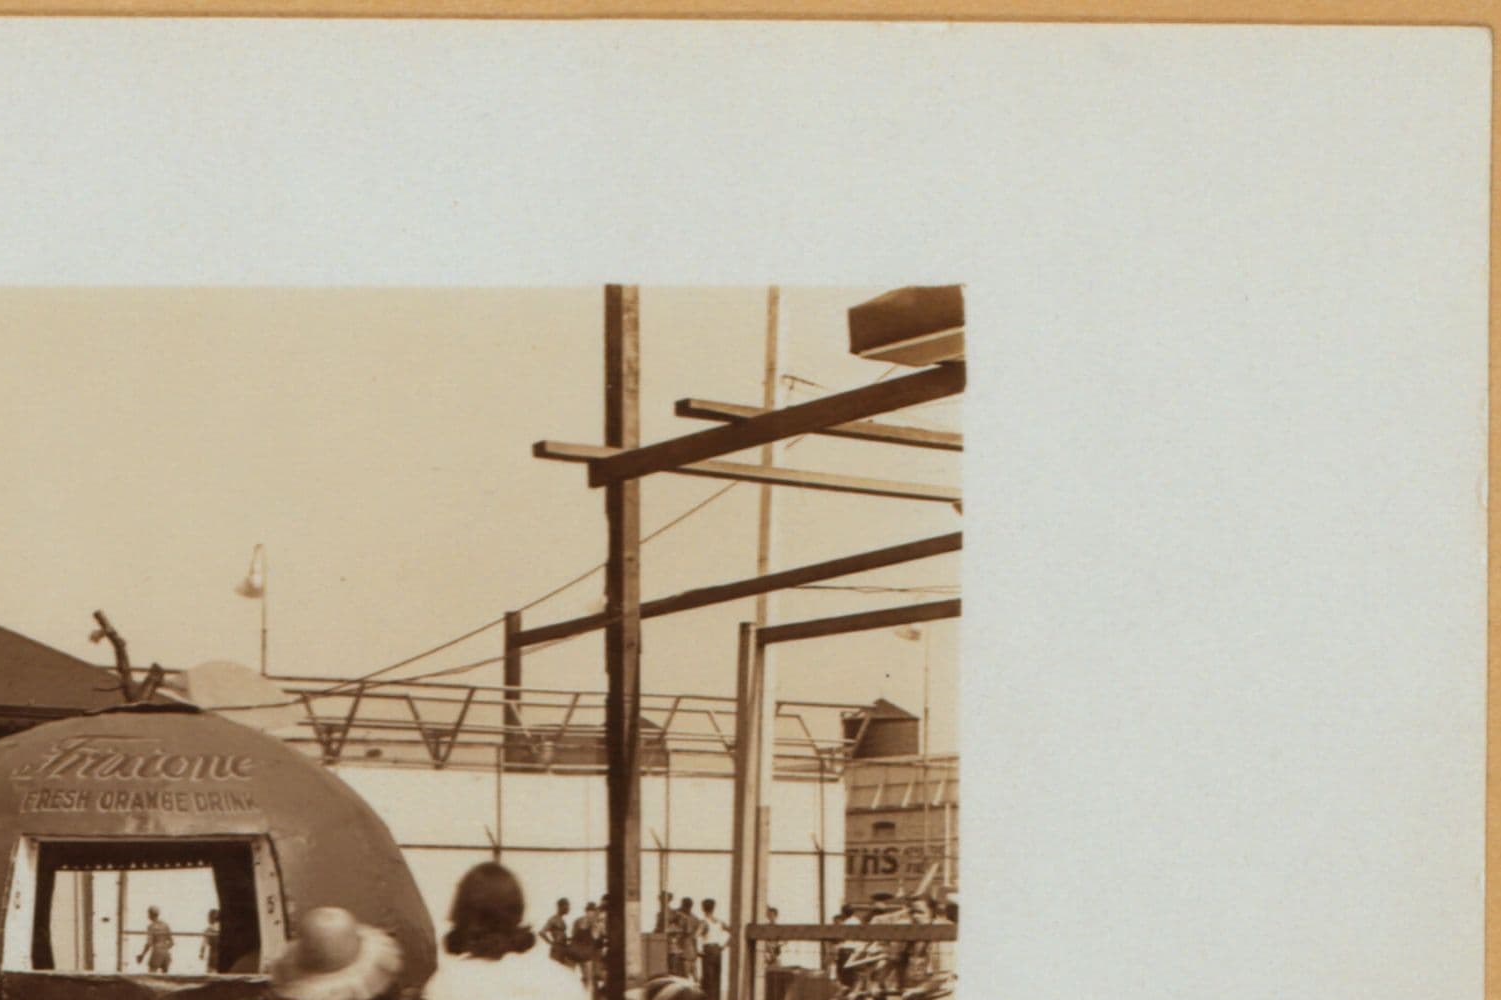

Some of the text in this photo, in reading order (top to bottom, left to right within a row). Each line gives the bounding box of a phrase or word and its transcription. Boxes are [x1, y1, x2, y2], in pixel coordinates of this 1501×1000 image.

[21, 789, 259, 813] FRESH ORANGE DRINK
